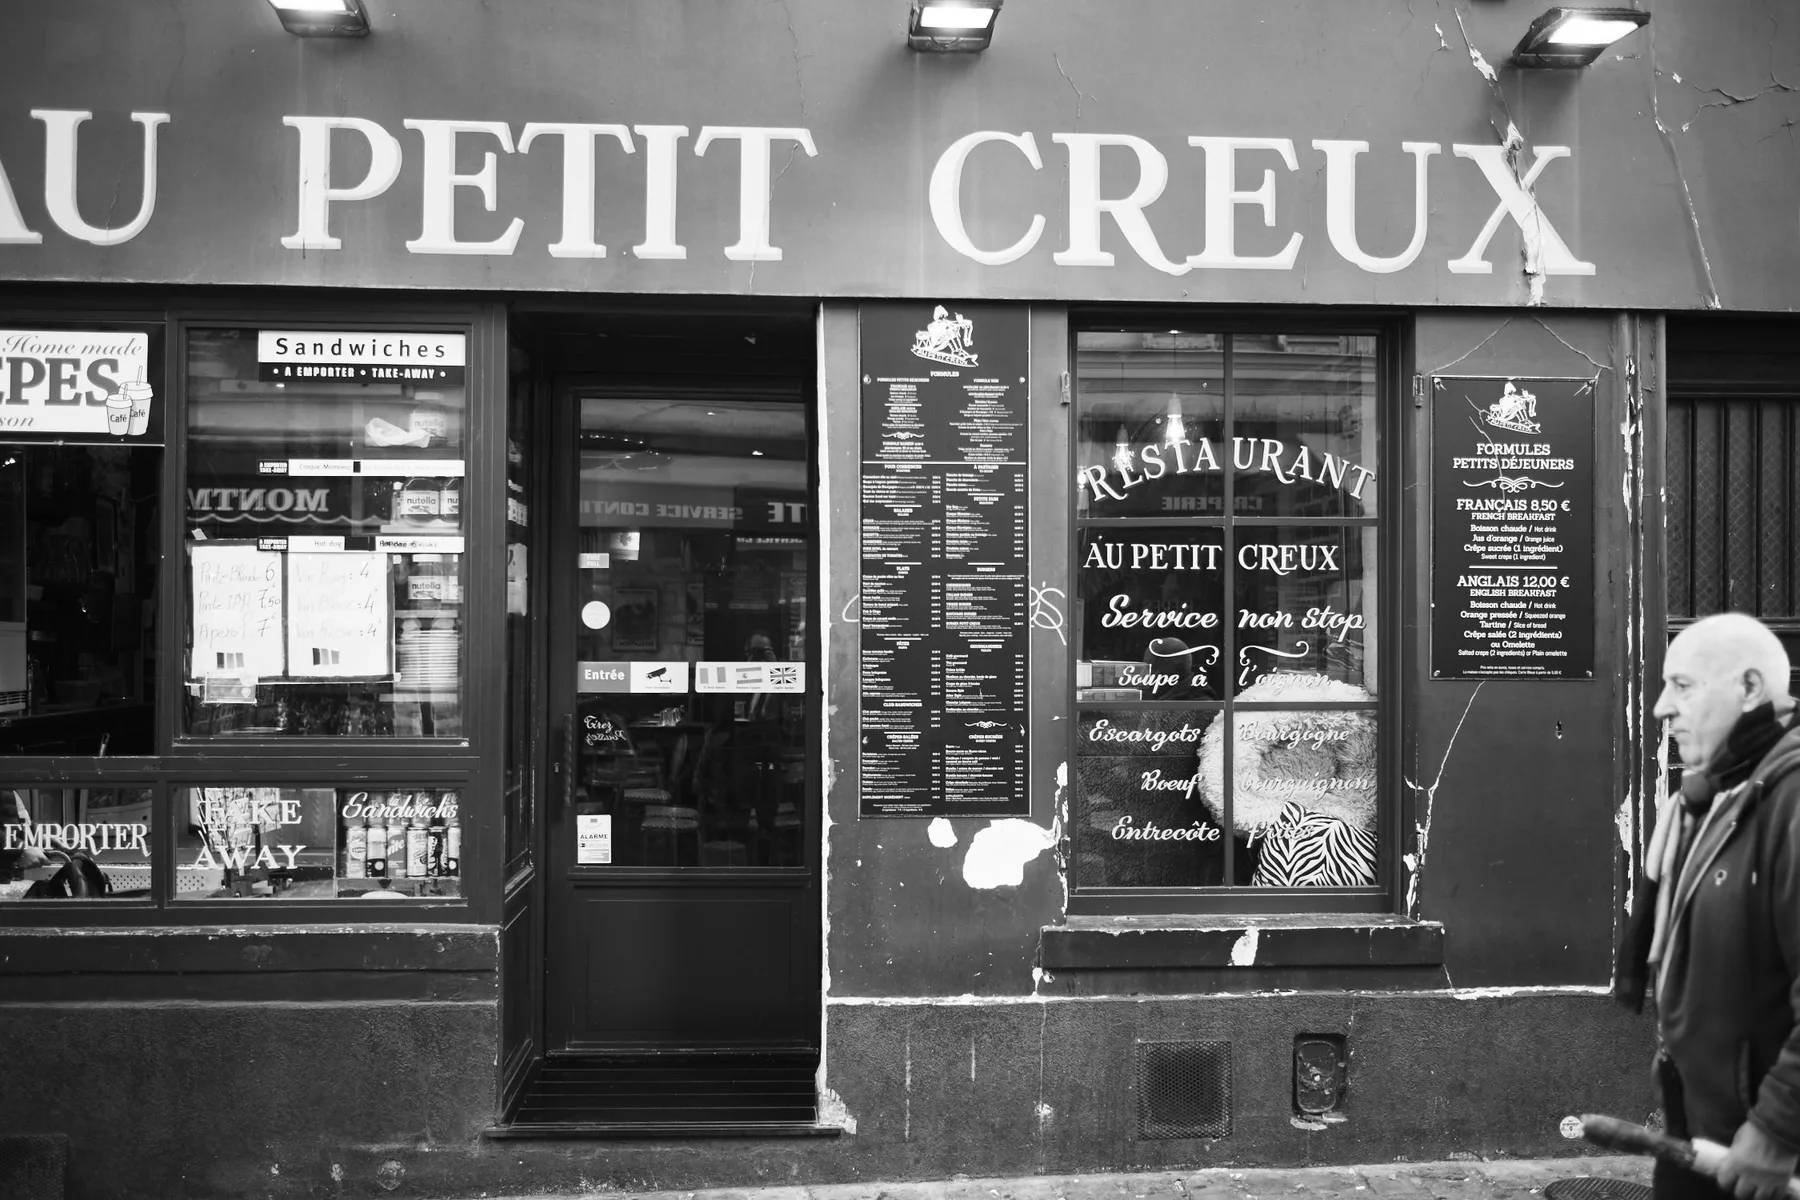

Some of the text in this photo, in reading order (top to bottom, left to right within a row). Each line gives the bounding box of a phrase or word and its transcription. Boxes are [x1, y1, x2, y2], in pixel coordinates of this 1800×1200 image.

[281, 115, 818, 262] PETIT
[928, 130, 1596, 276] CREUX
[2, 335, 144, 356] Home made
[275, 336, 446, 358] Sandwiches
[284, 366, 435, 380] A EMPORTER TAKE-AWAY
[0, 357, 119, 407] PES
[110, 414, 127, 422] Café
[1476, 443, 1551, 455] FORMULES
[1453, 456, 1574, 470] PETITS DÉJEUNERS
[1456, 498, 1570, 512] FRANÇAIS 8,50 €
[1470, 524, 1498, 532] Boisson
[1500, 524, 1527, 533] chaude
[1472, 534, 1484, 542] Jus
[1486, 534, 1518, 543] d'orange
[1464, 544, 1486, 553] Crêpe
[1488, 544, 1512, 552] sucrée
[1523, 545, 1563, 553] ingrédient)
[1083, 543, 1339, 576] AU PETIT CREUX
[411, 581, 441, 591] nutella
[1457, 576, 1570, 588] ANGLAIS 12,00 €
[1101, 594, 1219, 629] Service
[1237, 608, 1294, 629] non
[1500, 601, 1527, 609] chaude
[1460, 611, 1488, 619] Orange
[1490, 611, 1517, 619] pressée
[1464, 630, 1486, 639] Crêpe
[1488, 630, 1506, 638] salée
[1519, 631, 1562, 639] ingrédients)
[1502, 640, 1535, 648] Omelette
[584, 669, 625, 681] Entrée
[1118, 665, 1179, 694] Soupe
[1191, 666, 1207, 687] à
[584, 715, 613, 734] Tirez
[1089, 719, 1201, 752] Escargots
[197, 799, 303, 825] TAKE
[1112, 815, 1221, 842] Entrecôte
[3, 822, 152, 858] EMPORTER
[191, 844, 307, 870] AWAY
